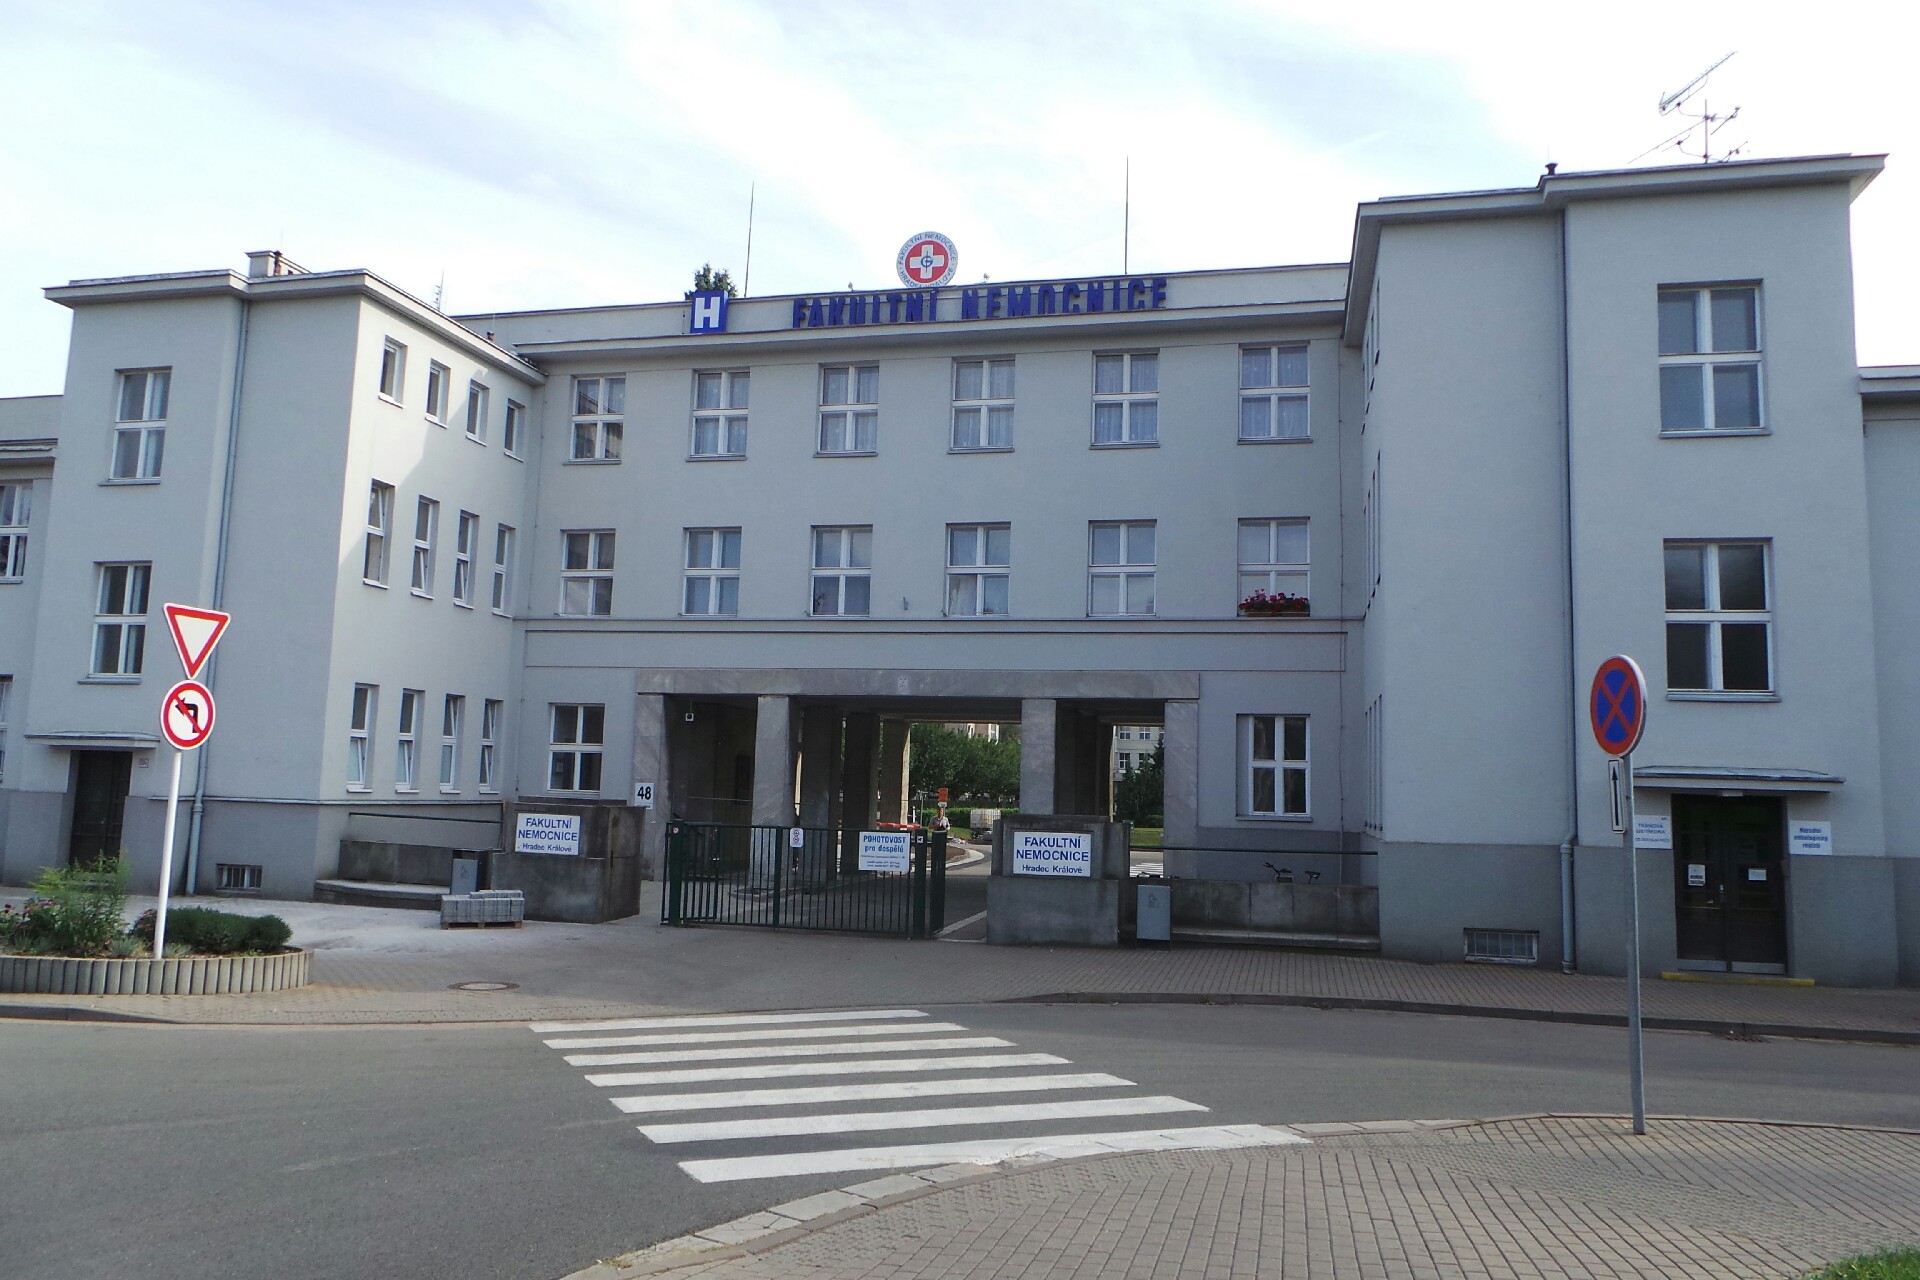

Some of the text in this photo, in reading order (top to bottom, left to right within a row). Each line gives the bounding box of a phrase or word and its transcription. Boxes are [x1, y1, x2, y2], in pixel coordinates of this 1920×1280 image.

[961, 278, 1168, 320] NEMOCNICE
[694, 297, 720, 328] H
[637, 786, 651, 800] 48
[526, 817, 573, 829] FAKULTNÍ
[518, 829, 578, 841] NEMOCNICE
[863, 835, 907, 844] POHOTOVOST
[522, 842, 572, 853] Hradec Králové
[1024, 836, 1082, 849] FAKULTNÍ
[864, 844, 904, 854] pro dospělé
[1016, 849, 1089, 862] NEMOCNICE
[1022, 864, 1083, 874] Hradec Králové
